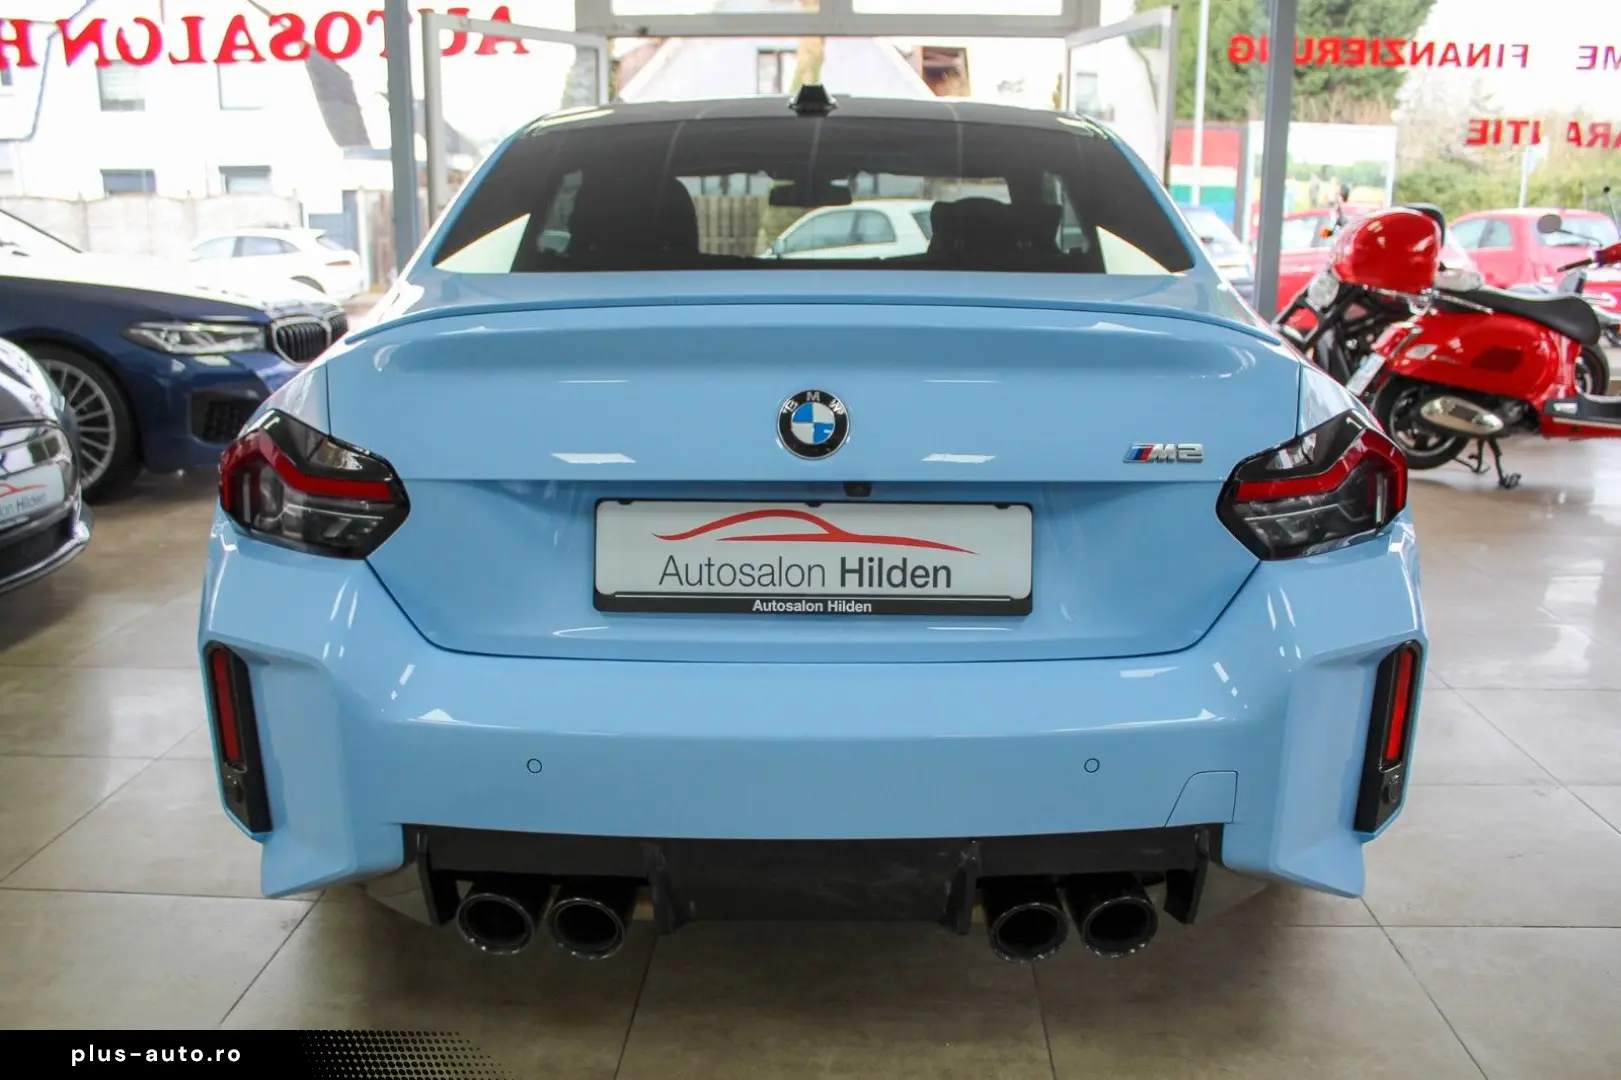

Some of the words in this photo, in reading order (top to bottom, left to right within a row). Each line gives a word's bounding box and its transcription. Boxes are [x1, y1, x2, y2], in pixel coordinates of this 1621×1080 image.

[782, 391, 845, 415] BMW
[659, 555, 825, 588] Autosalon
[840, 557, 951, 589] Hilden
[752, 599, 823, 613] Autosalon
[827, 600, 872, 613] Hilden
